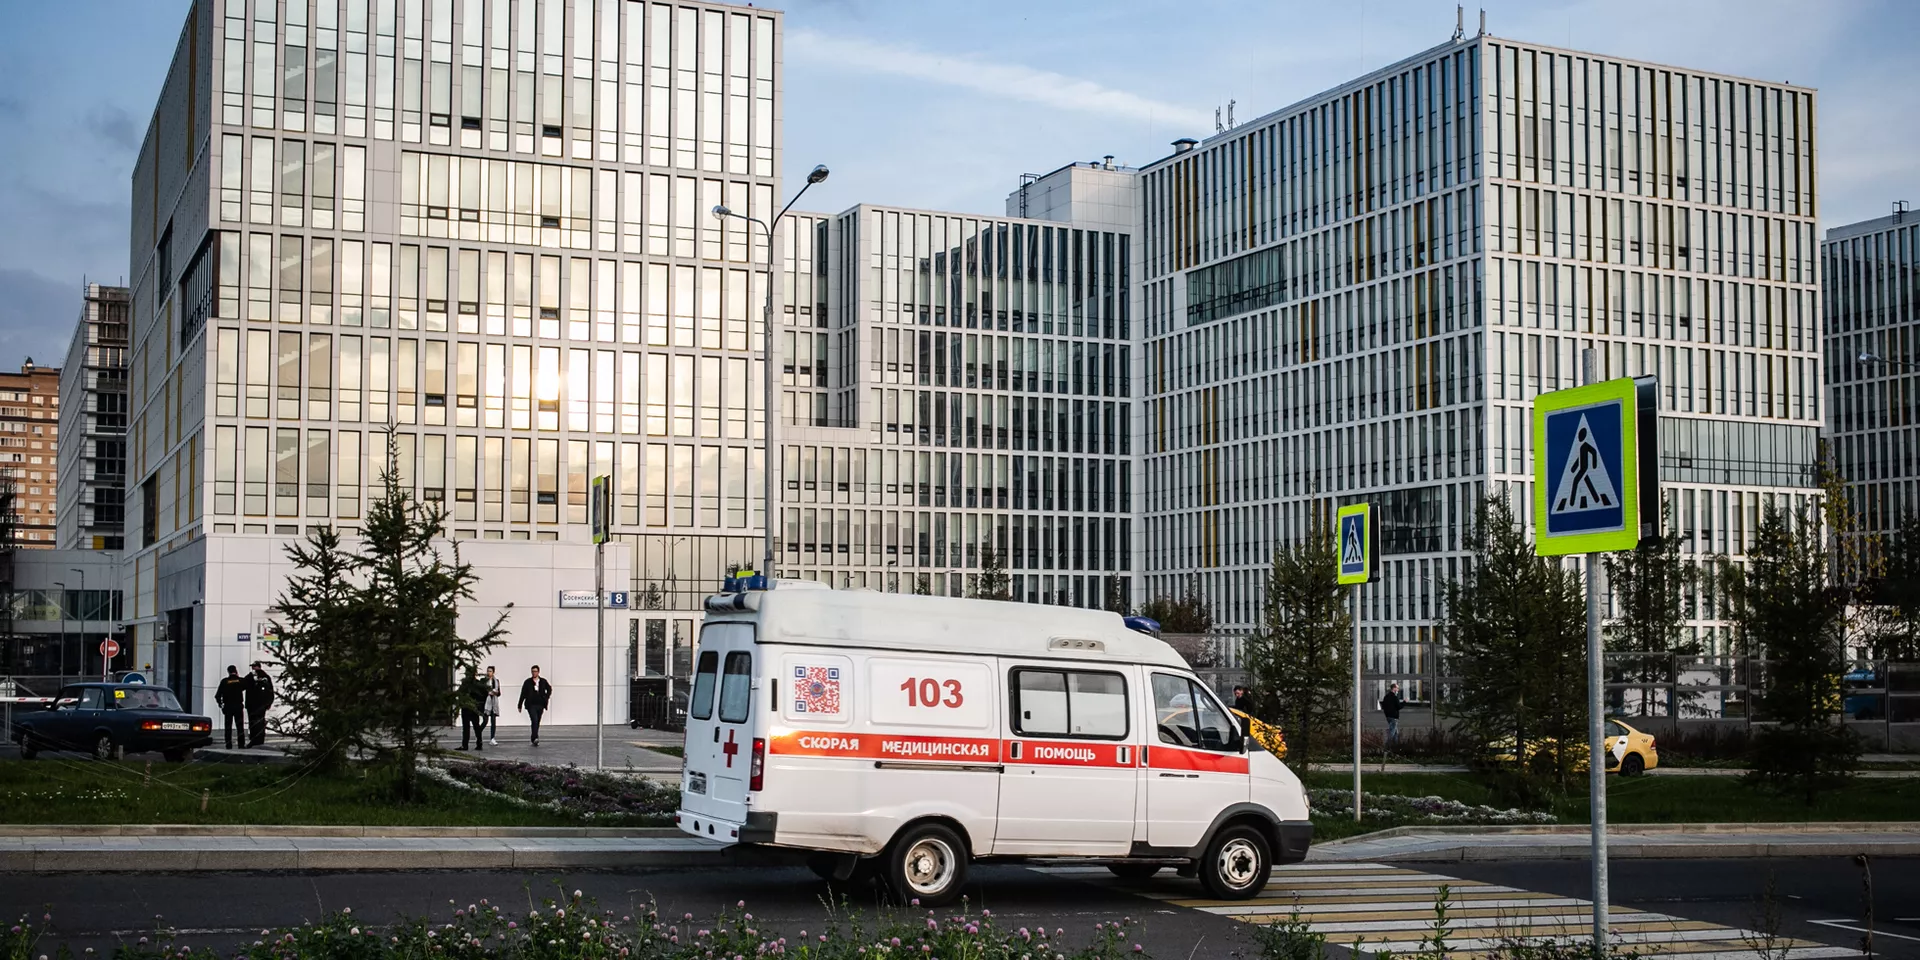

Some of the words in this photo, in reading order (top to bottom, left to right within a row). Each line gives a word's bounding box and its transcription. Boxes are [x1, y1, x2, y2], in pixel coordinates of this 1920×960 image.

[615, 593, 623, 604] 8
[900, 677, 964, 709] 103
[799, 736, 860, 751] СКОРАЯ
[882, 740, 989, 756] МЕДИЦИНСКАЯ
[1034, 746, 1096, 761] ПОМОЩЬ
